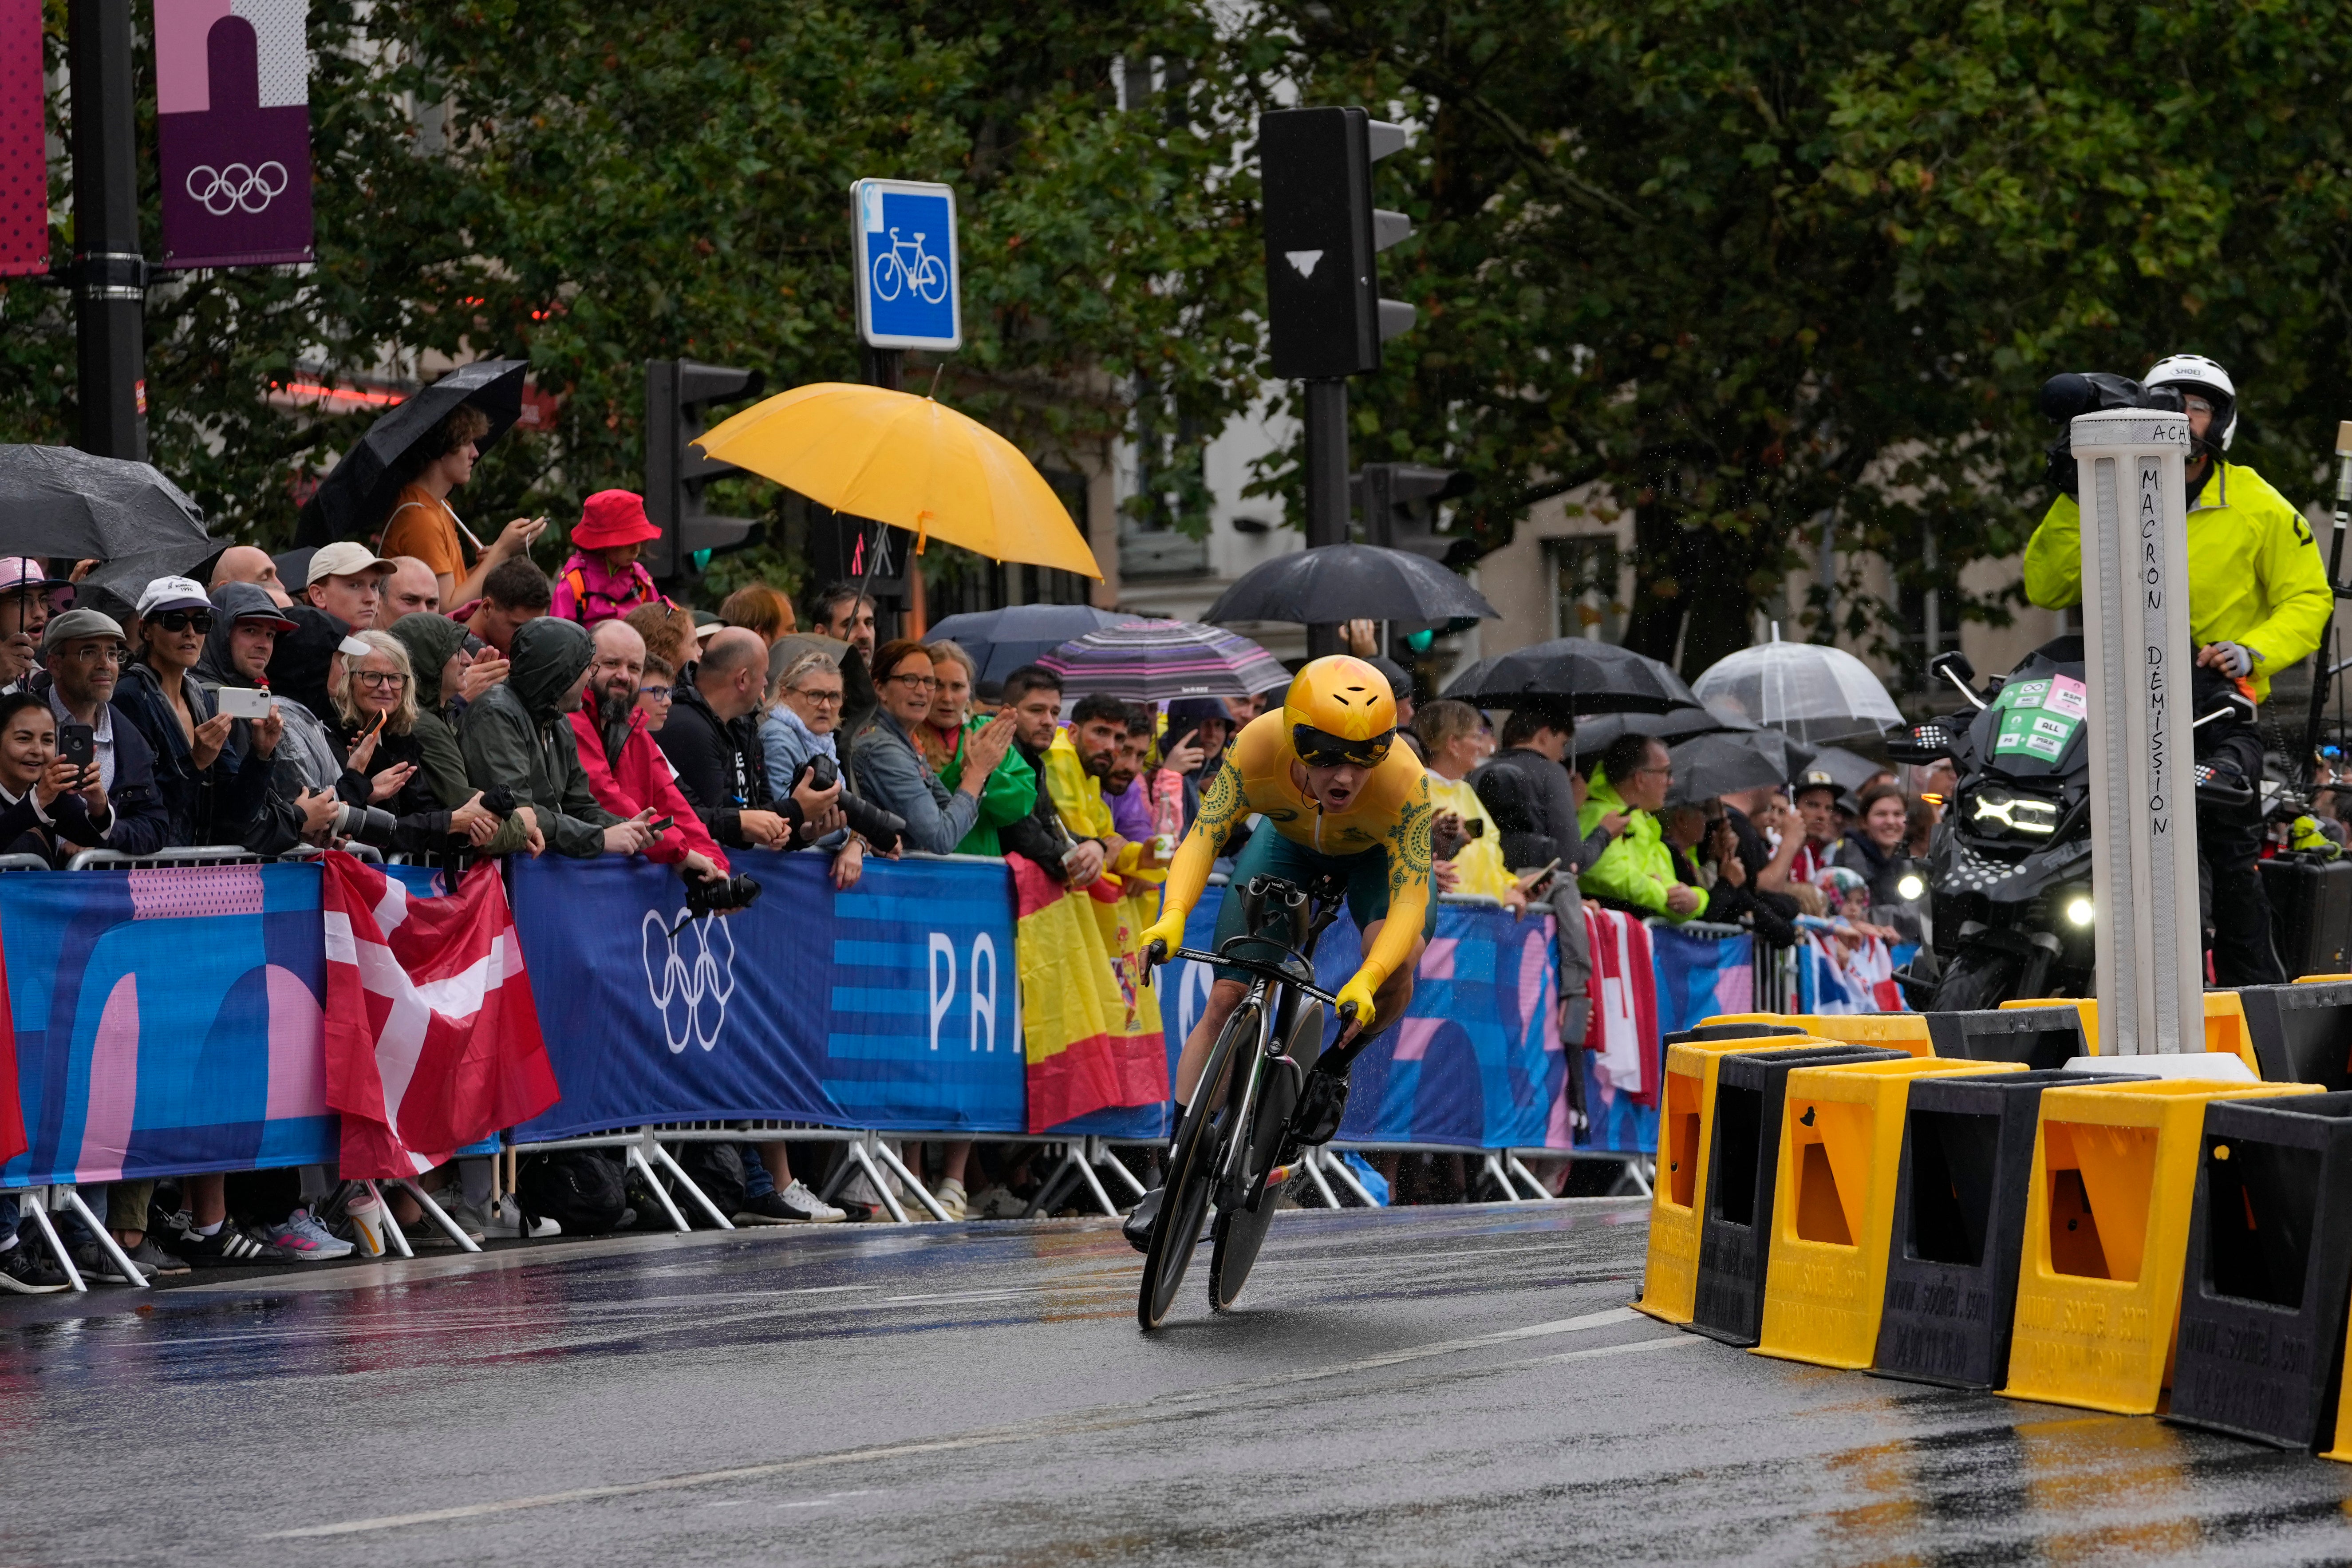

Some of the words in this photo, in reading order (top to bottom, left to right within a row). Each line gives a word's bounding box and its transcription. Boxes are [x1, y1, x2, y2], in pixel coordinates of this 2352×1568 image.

[2175, 367, 2201, 376] SHOEI
[2142, 470, 2161, 609] MACRON
[2042, 722, 2059, 733] ALL
[1176, 951, 1231, 964] LAPIERRE
[1295, 982, 1336, 1003] LAPIERR
